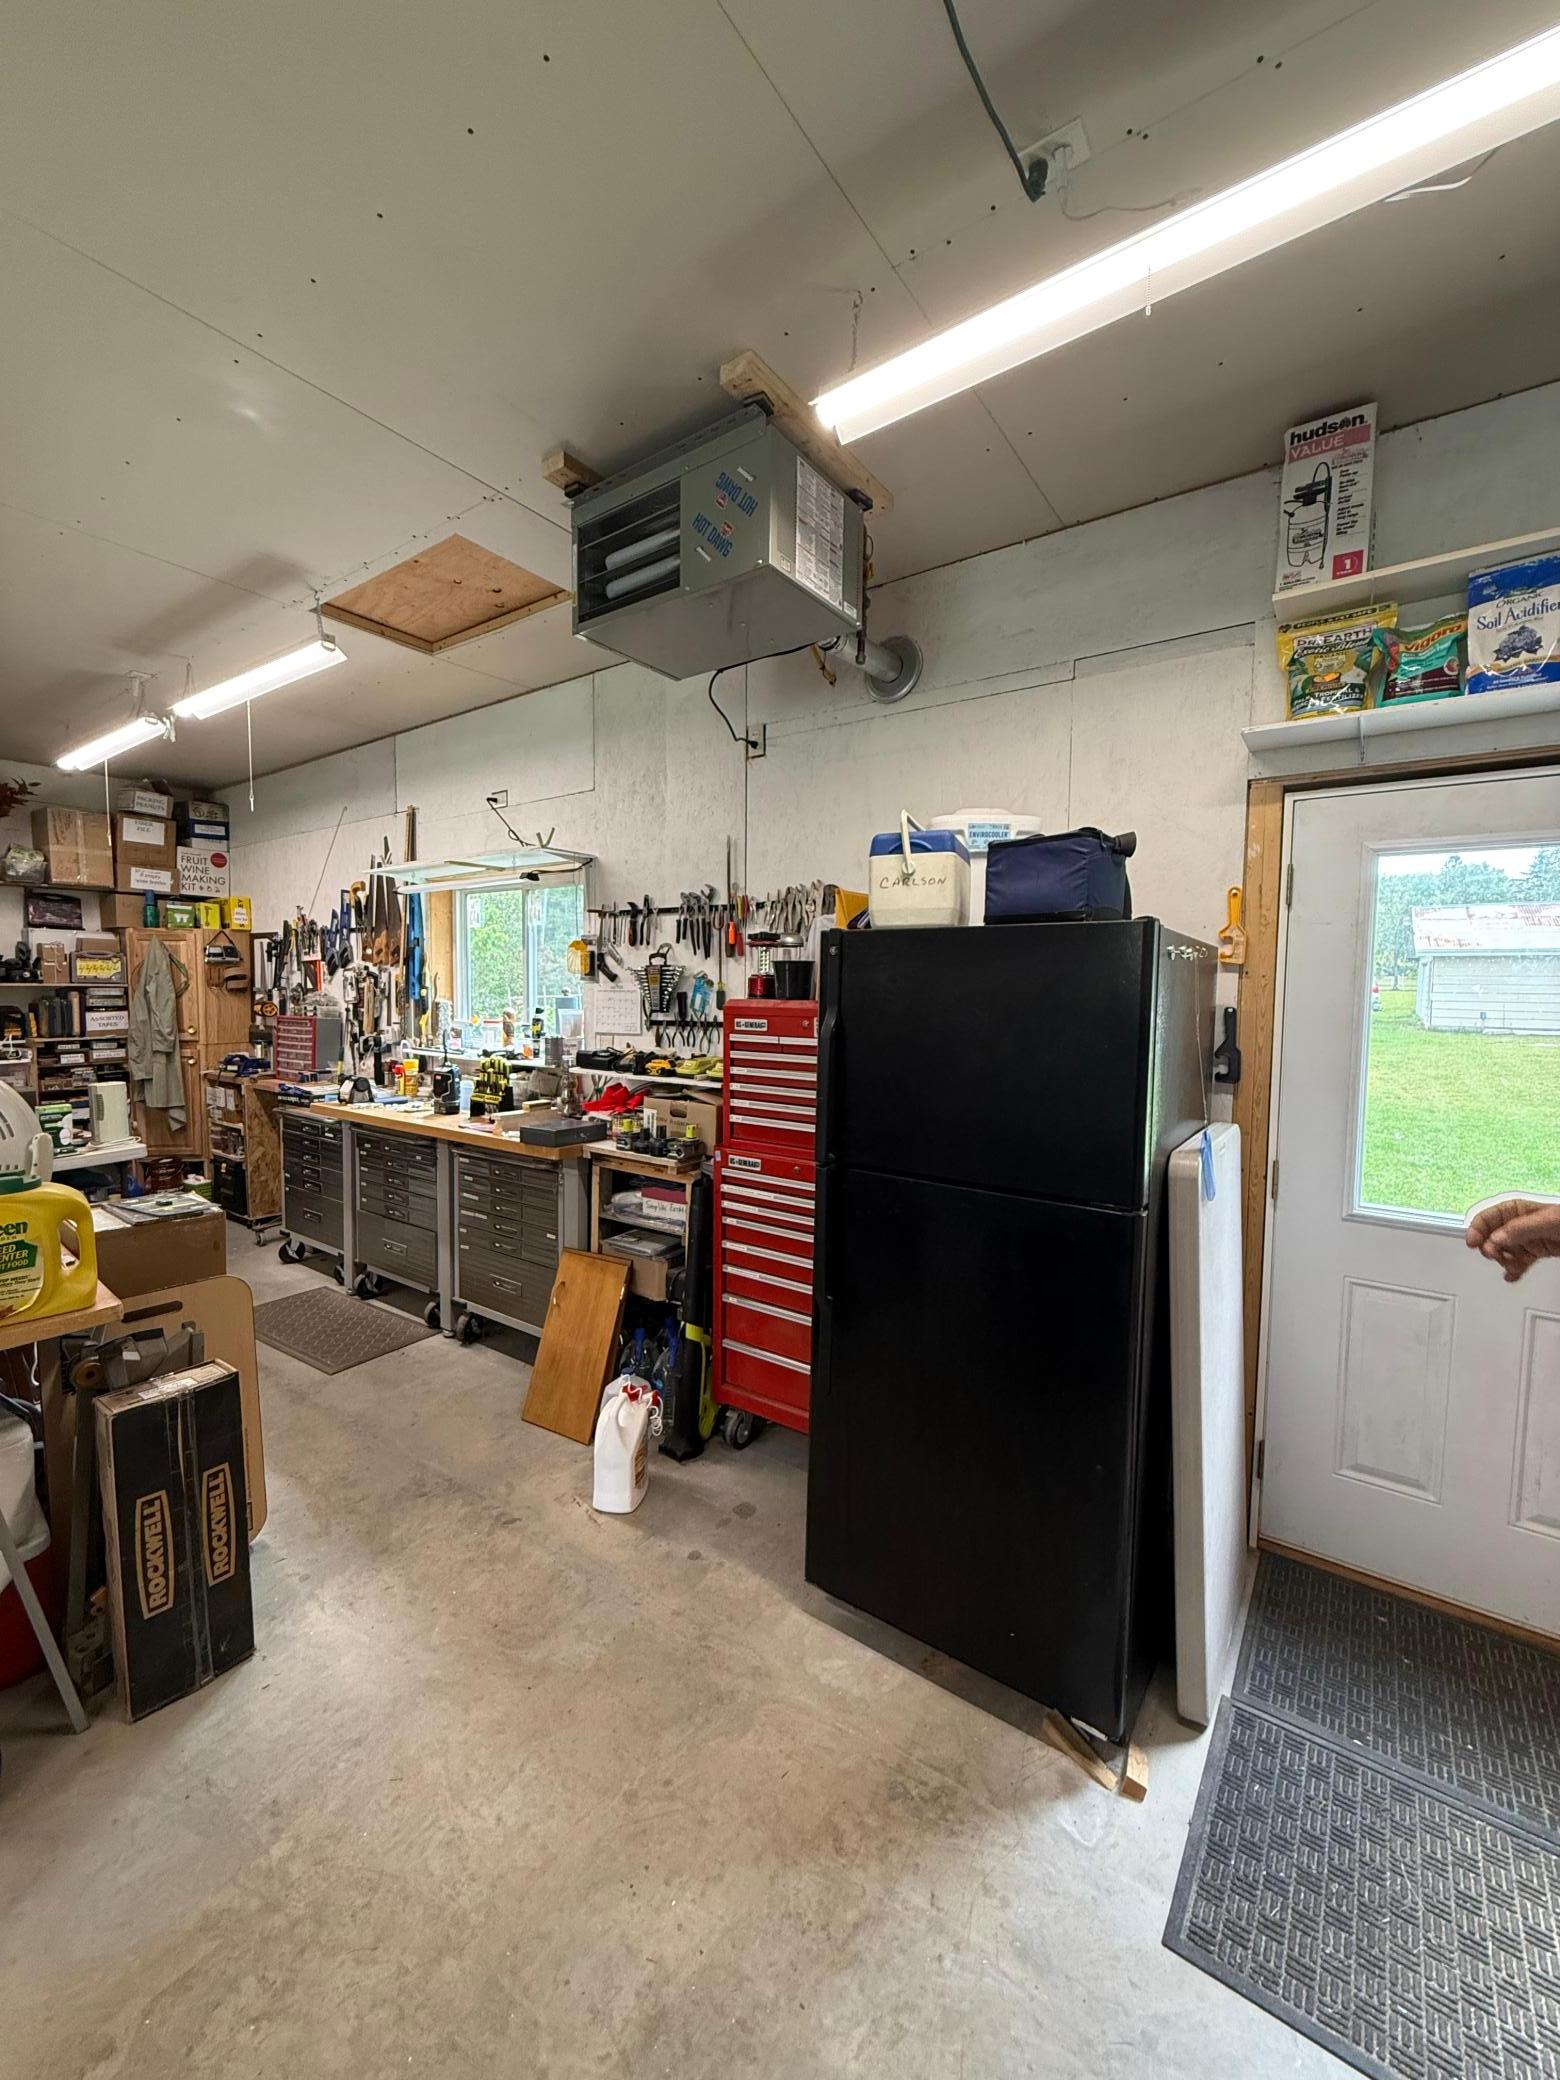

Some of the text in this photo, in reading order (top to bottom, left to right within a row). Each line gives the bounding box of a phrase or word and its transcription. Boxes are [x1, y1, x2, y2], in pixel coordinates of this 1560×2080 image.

[1290, 414, 1365, 446] hudson
[1291, 434, 1344, 458] VALUE
[715, 472, 758, 517] HOT DAWG
[692, 512, 733, 557] HOT DAWG
[1344, 558, 1352, 570] 1
[1477, 612, 1502, 630] Soil
[1323, 627, 1372, 646] EARTH
[181, 855, 208, 865] FRUIT
[180, 864, 210, 875] WINE
[181, 874, 226, 885] MAKING
[181, 883, 196, 891] KIT
[879, 875, 949, 890] CARLSON
[90, 1014, 125, 1022] ASSORTED
[0, 1244, 16, 1254] ED
[208, 1471, 230, 1575] ROCKWELL
[142, 1496, 168, 1607] ROCKWELL
